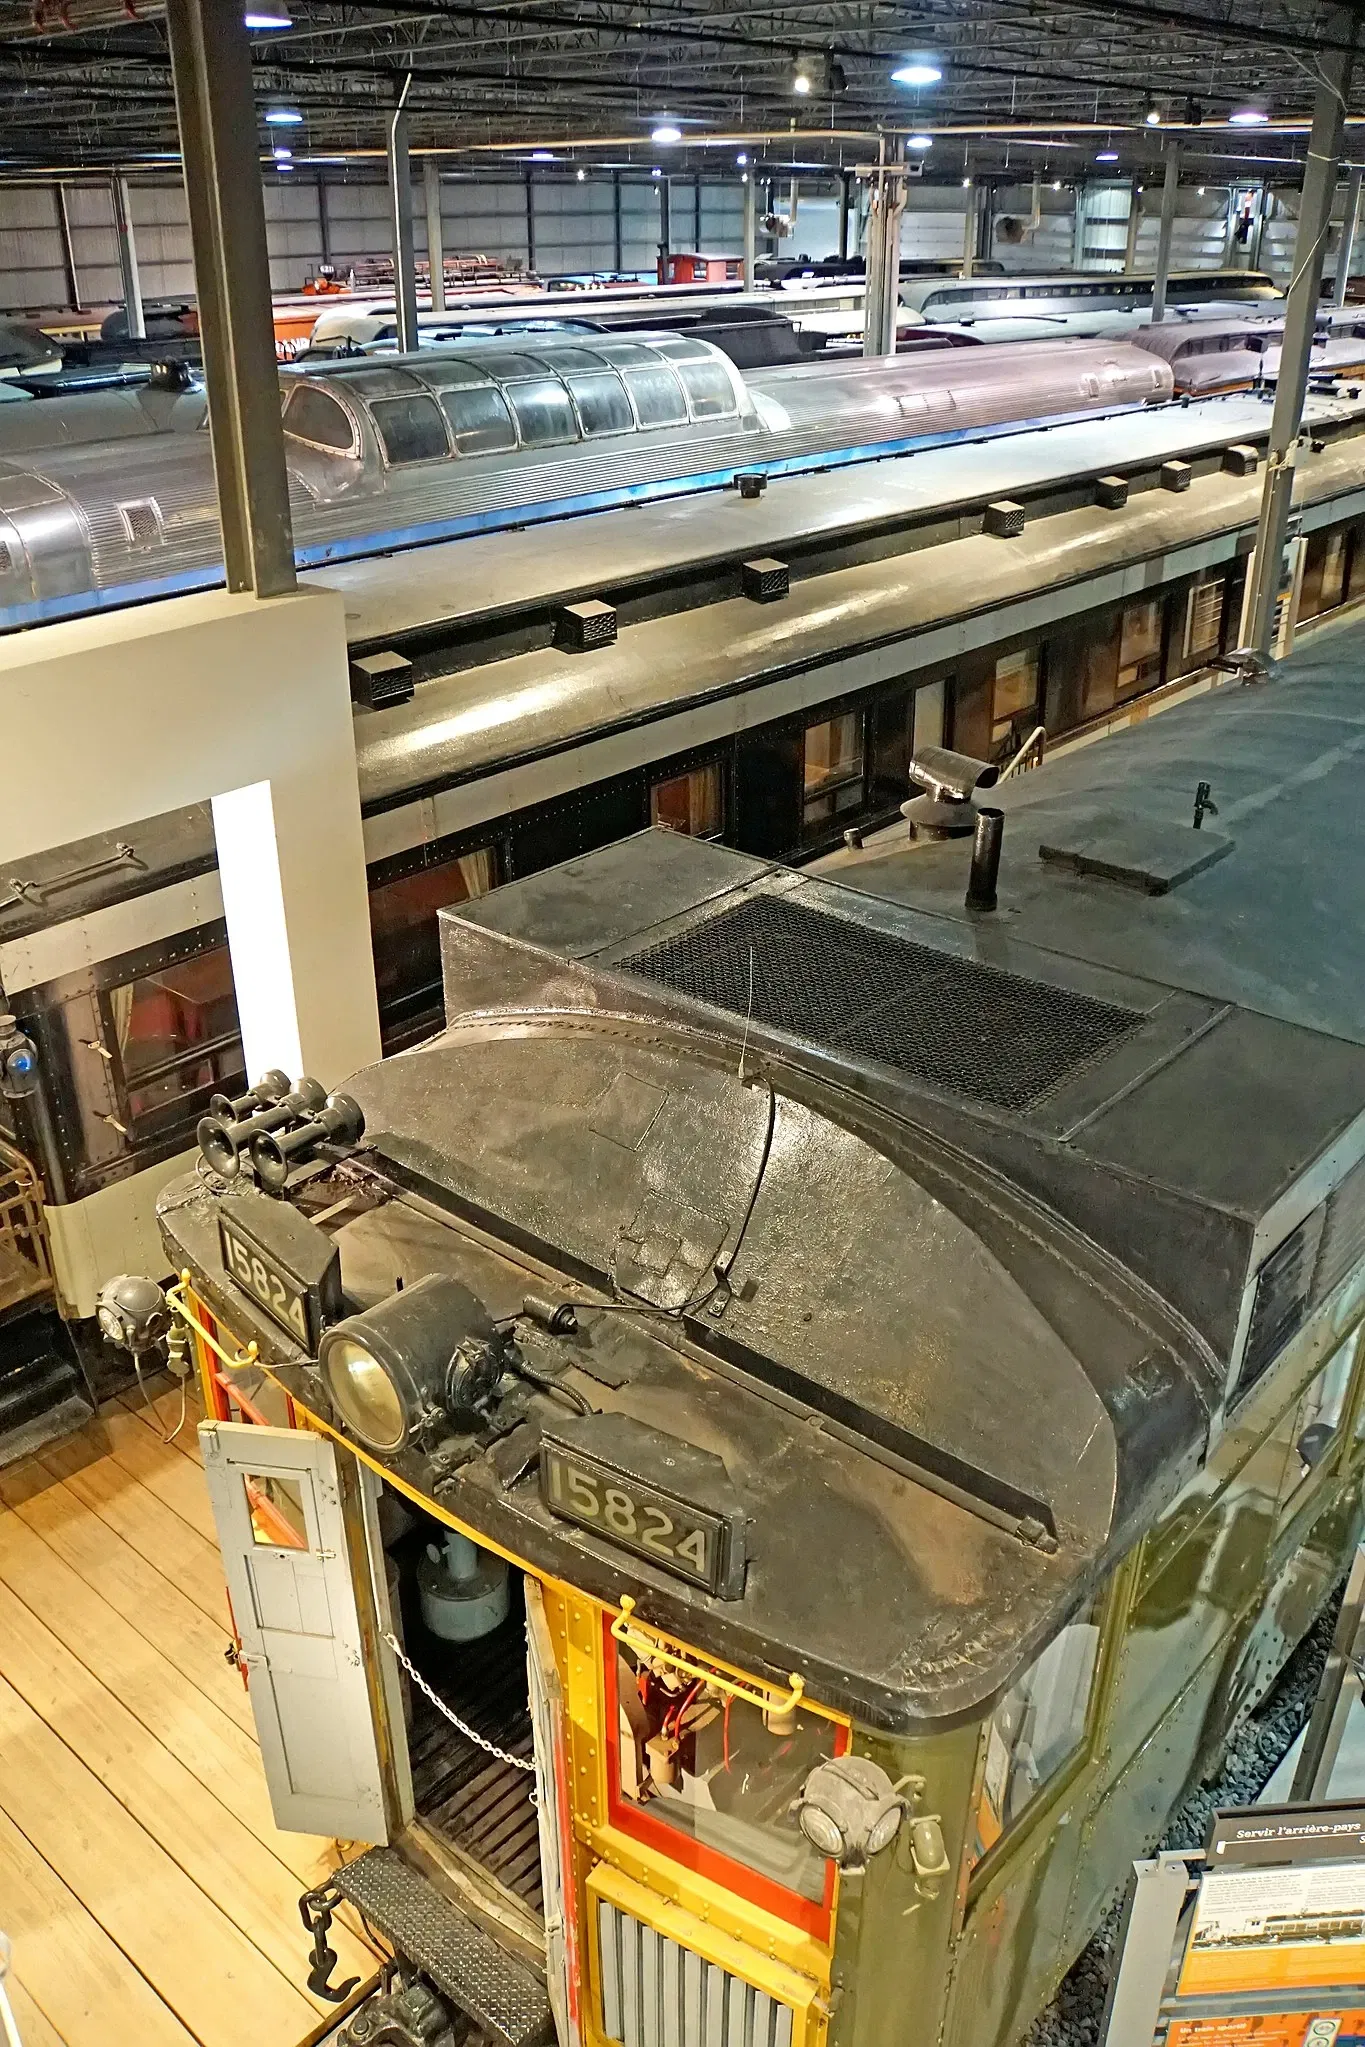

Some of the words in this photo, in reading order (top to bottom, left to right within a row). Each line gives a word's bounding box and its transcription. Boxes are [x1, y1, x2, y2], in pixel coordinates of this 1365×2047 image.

[224, 1230, 306, 1338] 15824
[551, 1461, 706, 1573] 15824
[1236, 1828, 1276, 1839] Servir
[1277, 1823, 1361, 1835] l'arrière-pays
